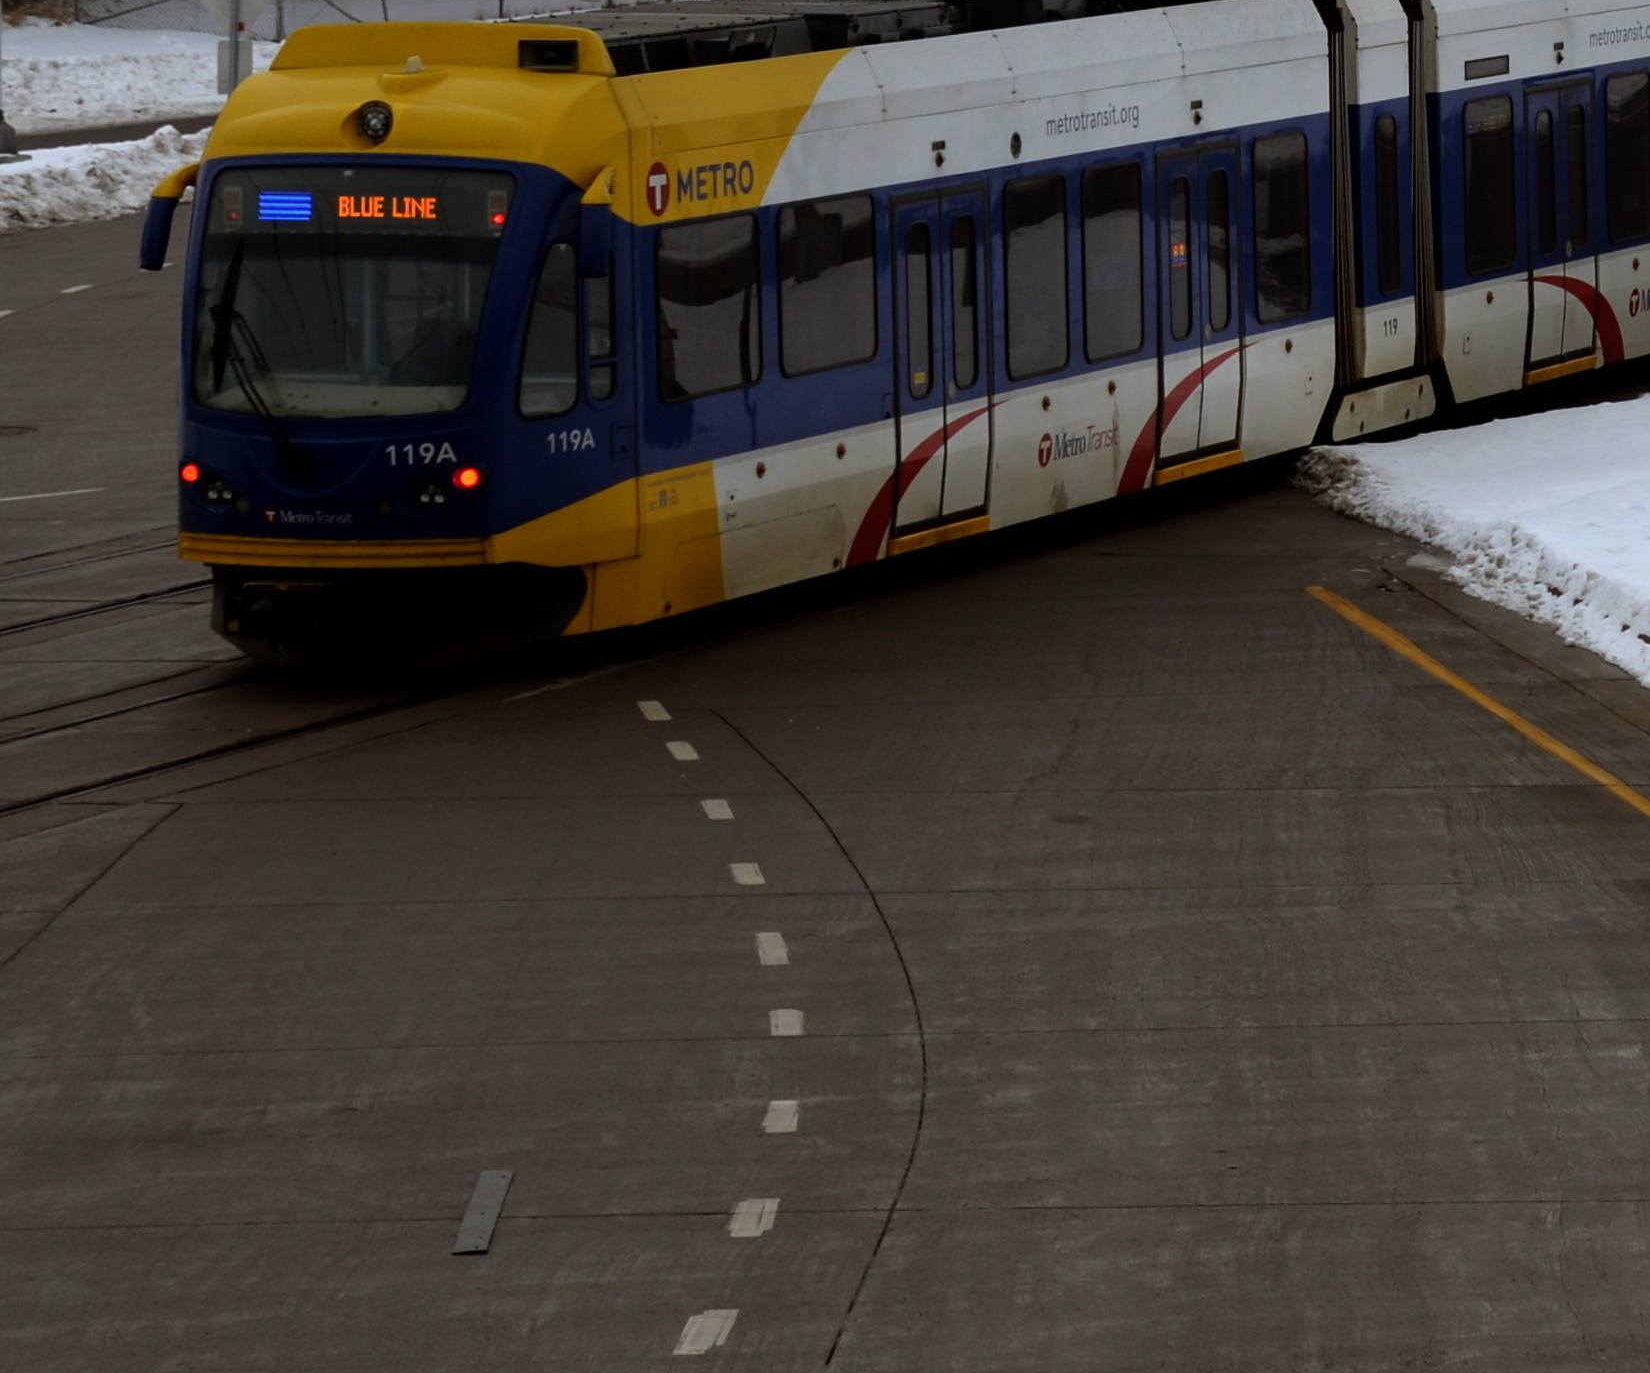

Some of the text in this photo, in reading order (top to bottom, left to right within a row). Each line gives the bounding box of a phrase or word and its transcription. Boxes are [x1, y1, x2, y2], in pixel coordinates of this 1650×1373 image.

[1046, 102, 1140, 138] metrotransit.org
[677, 160, 754, 204] METRO
[338, 195, 437, 219] BLUE LINE
[1384, 317, 1398, 337] 119
[385, 442, 458, 466] 119A
[546, 428, 597, 454] 119A
[1053, 431, 1086, 461] Metro
